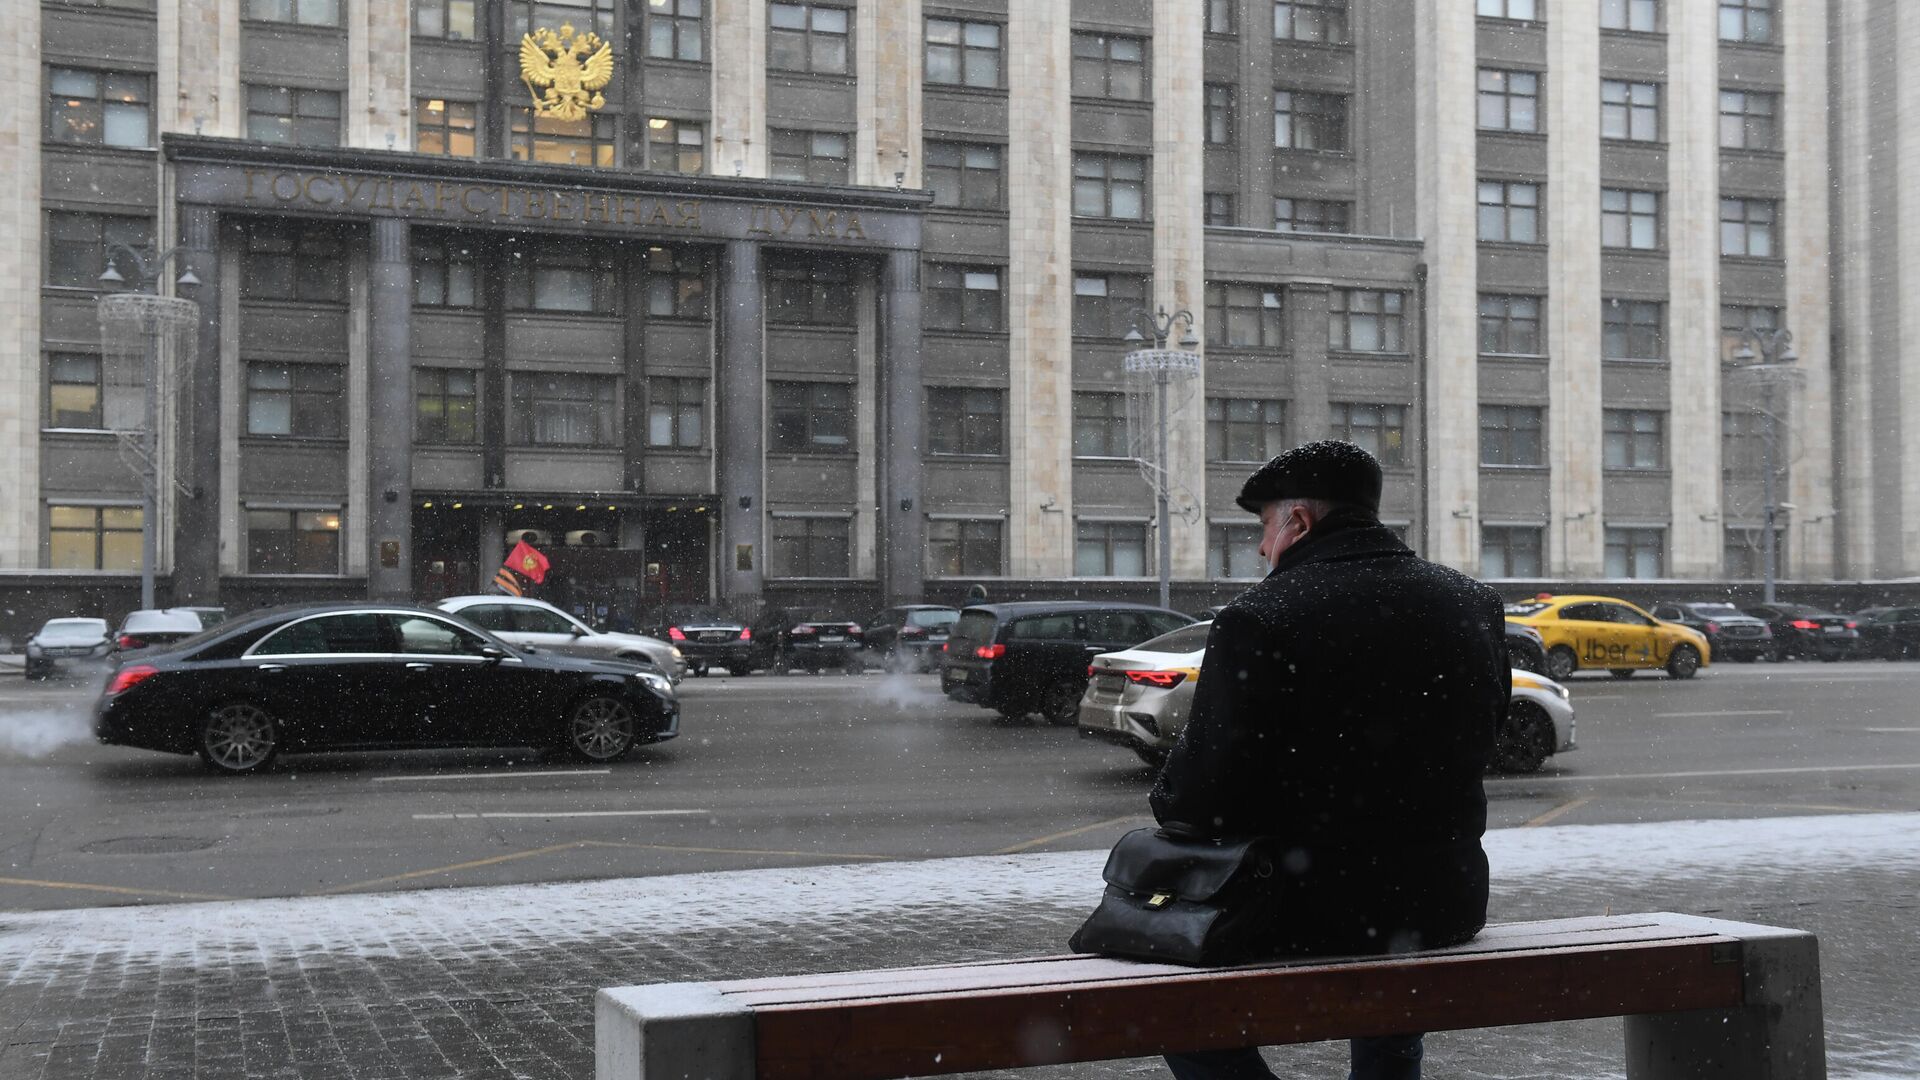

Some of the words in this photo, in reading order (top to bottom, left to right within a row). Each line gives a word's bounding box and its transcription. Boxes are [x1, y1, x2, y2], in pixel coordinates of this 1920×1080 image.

[243, 168, 701, 229] ГОСУДАРСТВЕННАЯ
[747, 205, 867, 239] ДУМА
[1575, 638, 1630, 661] Uber
